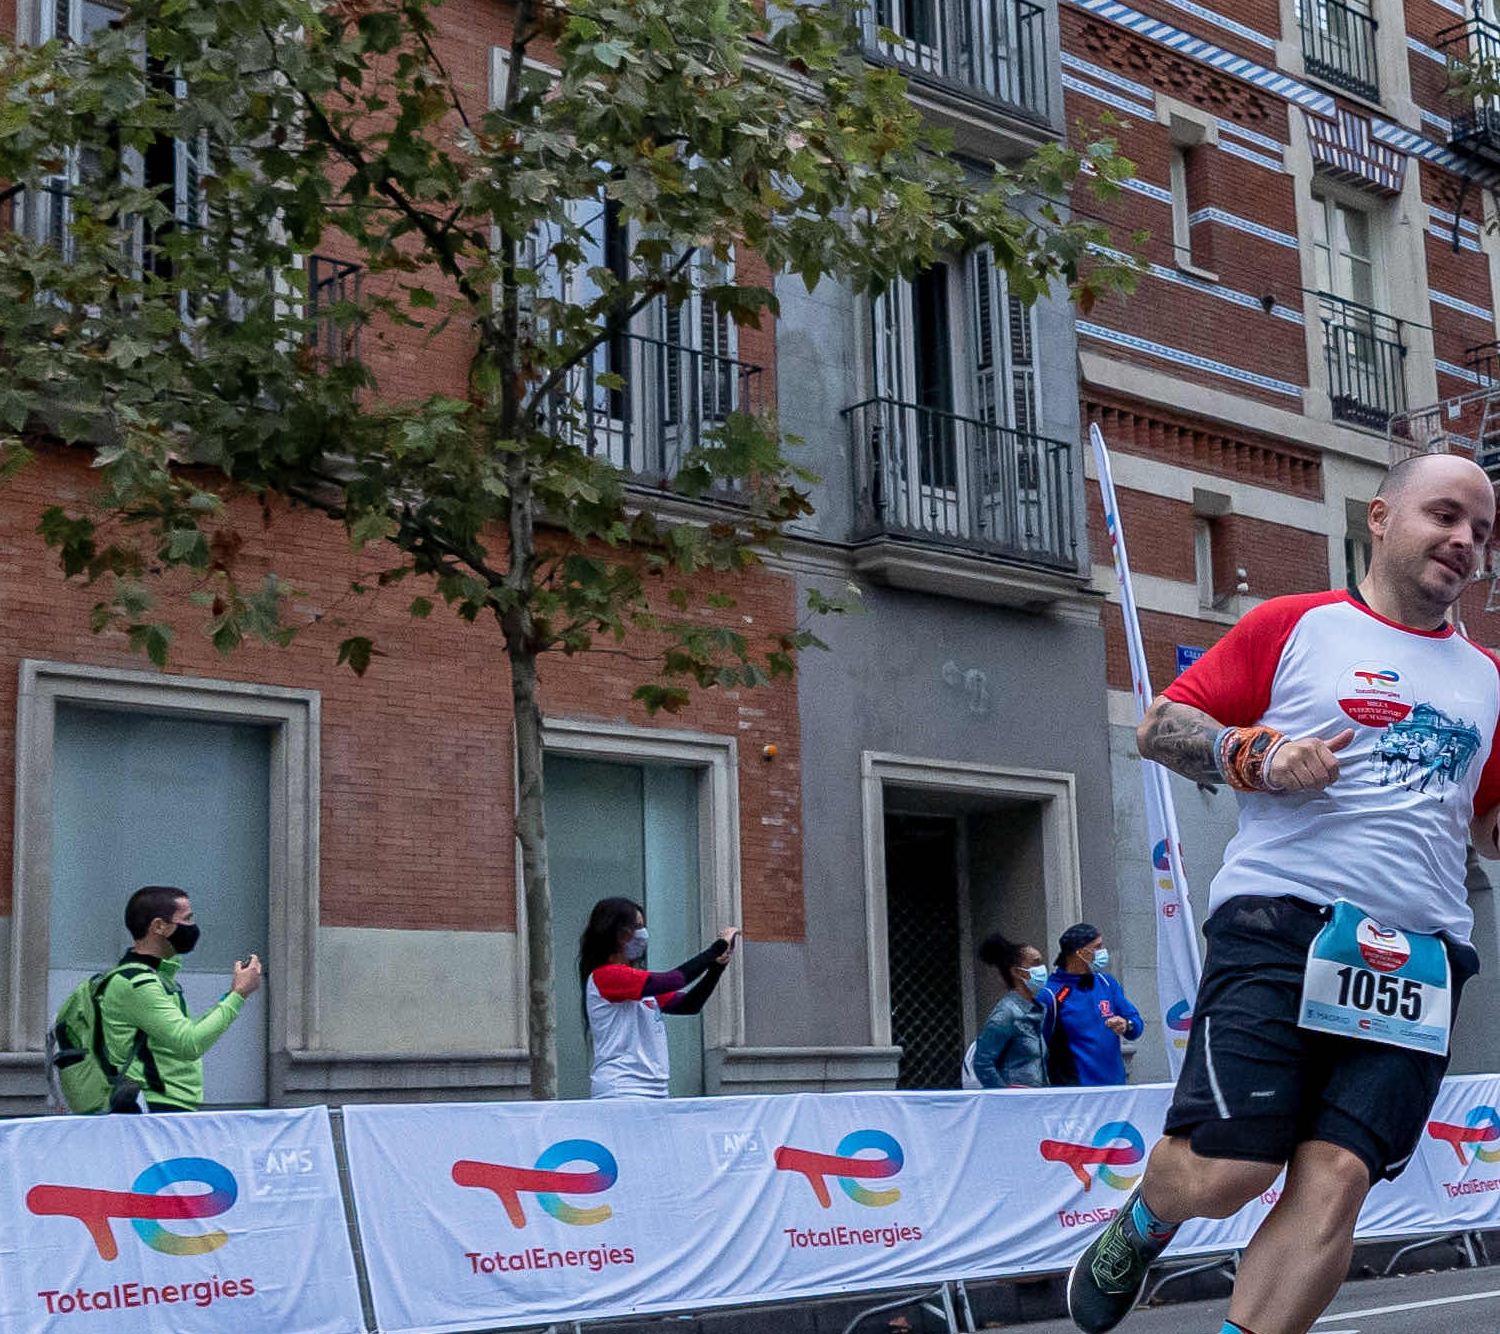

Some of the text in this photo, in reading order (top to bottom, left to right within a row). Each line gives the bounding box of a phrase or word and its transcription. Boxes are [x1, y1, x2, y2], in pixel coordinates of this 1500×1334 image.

[1337, 966, 1422, 1022] 1055
[1058, 1207, 1118, 1228] TotalEn
[784, 1222, 923, 1249] TotalEnergies
[465, 1243, 635, 1275] TotalEnergies
[38, 1275, 255, 1316] TotalEnergies
